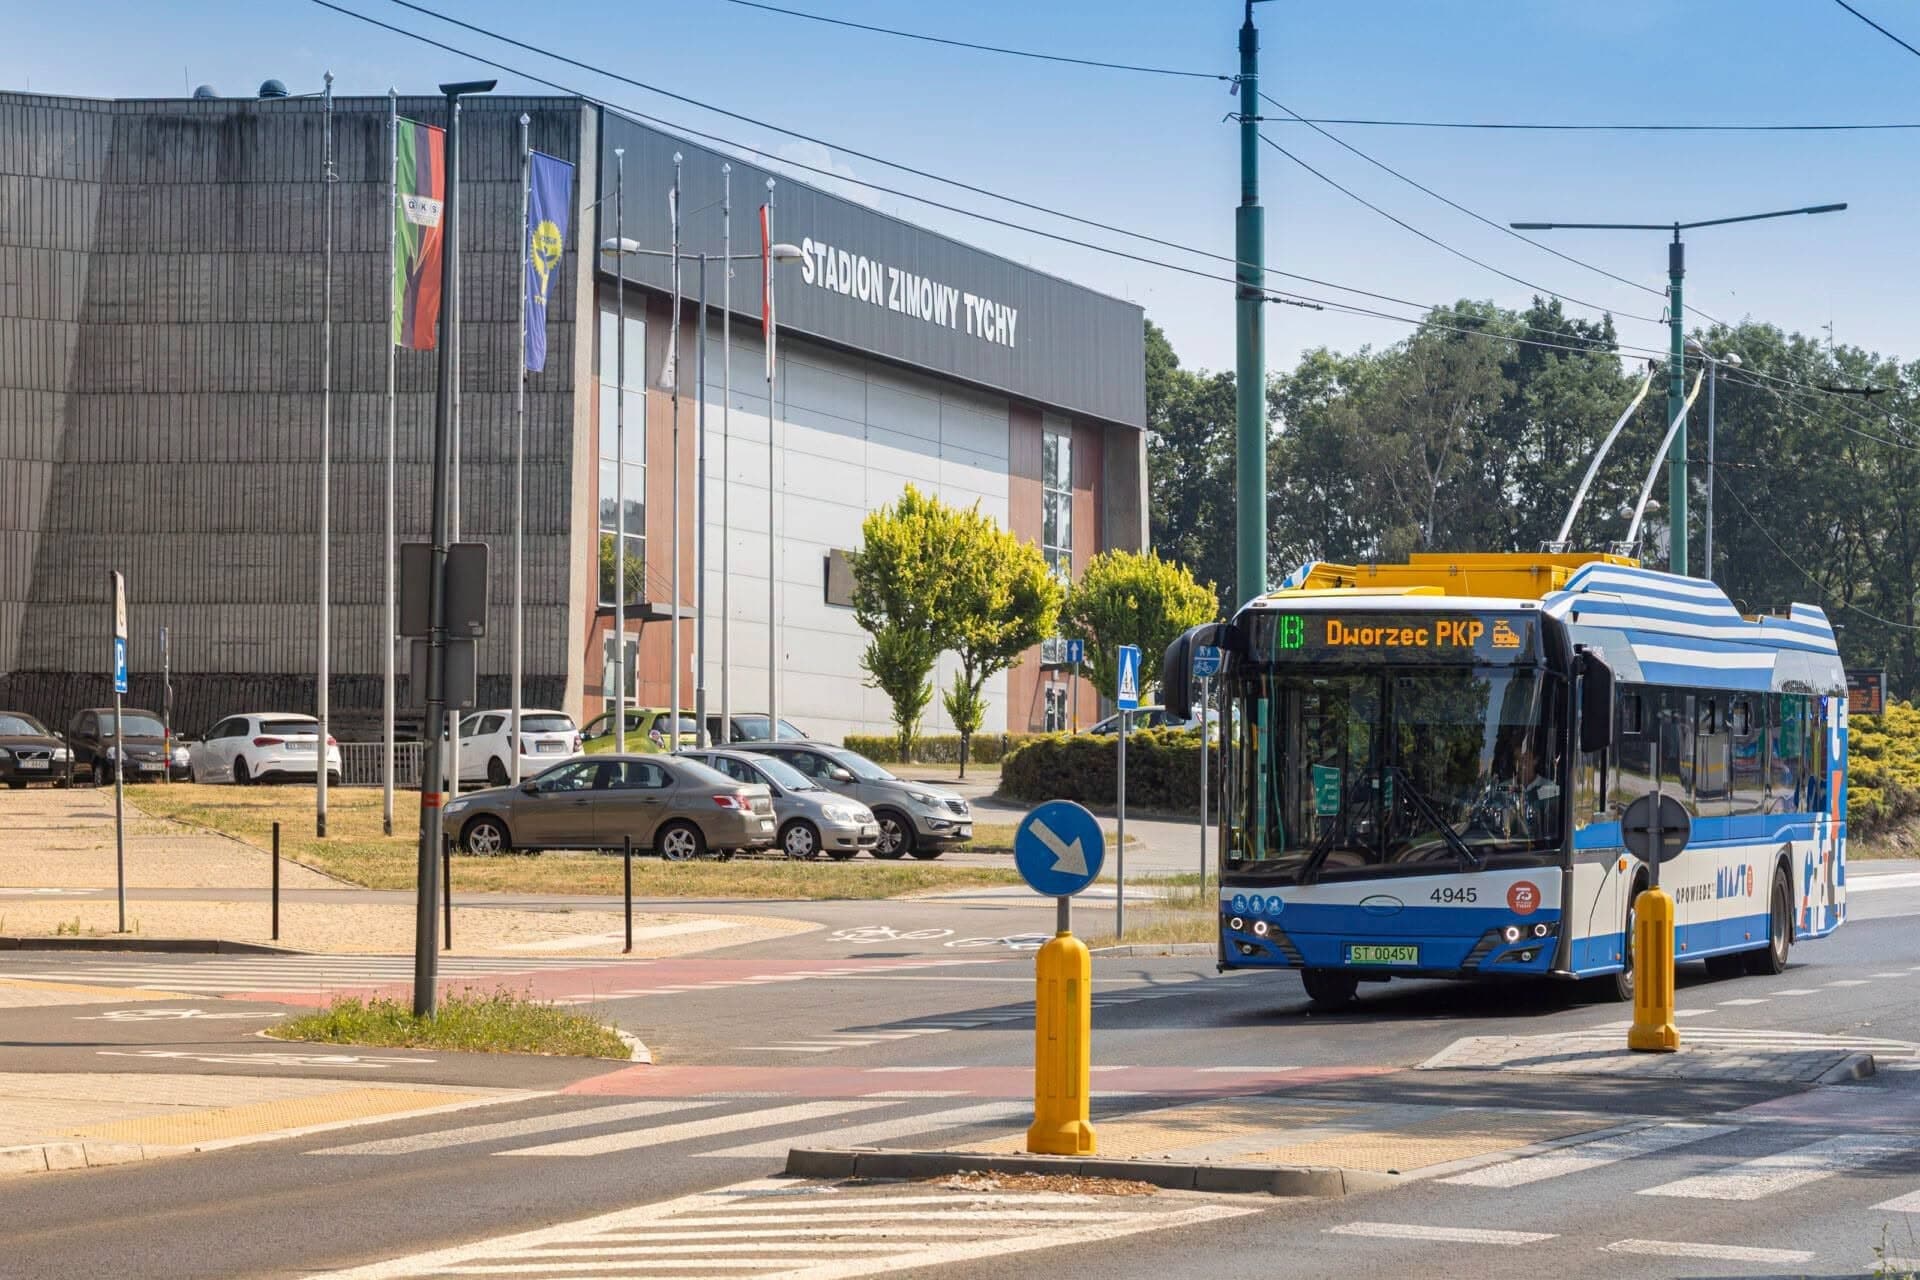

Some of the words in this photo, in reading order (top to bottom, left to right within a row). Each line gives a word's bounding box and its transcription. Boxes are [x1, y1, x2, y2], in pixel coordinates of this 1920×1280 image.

[801, 237, 884, 307] STADION
[888, 266, 959, 330] ZIMOWY
[963, 292, 1018, 349] TYCHY
[1280, 615, 1304, 649] B
[1326, 619, 1429, 647] Dworzec
[1435, 618, 1485, 647] PKP
[117, 643, 124, 675] P
[1430, 887, 1477, 903] 4945
[1354, 947, 1370, 960] ST
[1375, 947, 1414, 960] 0045V
